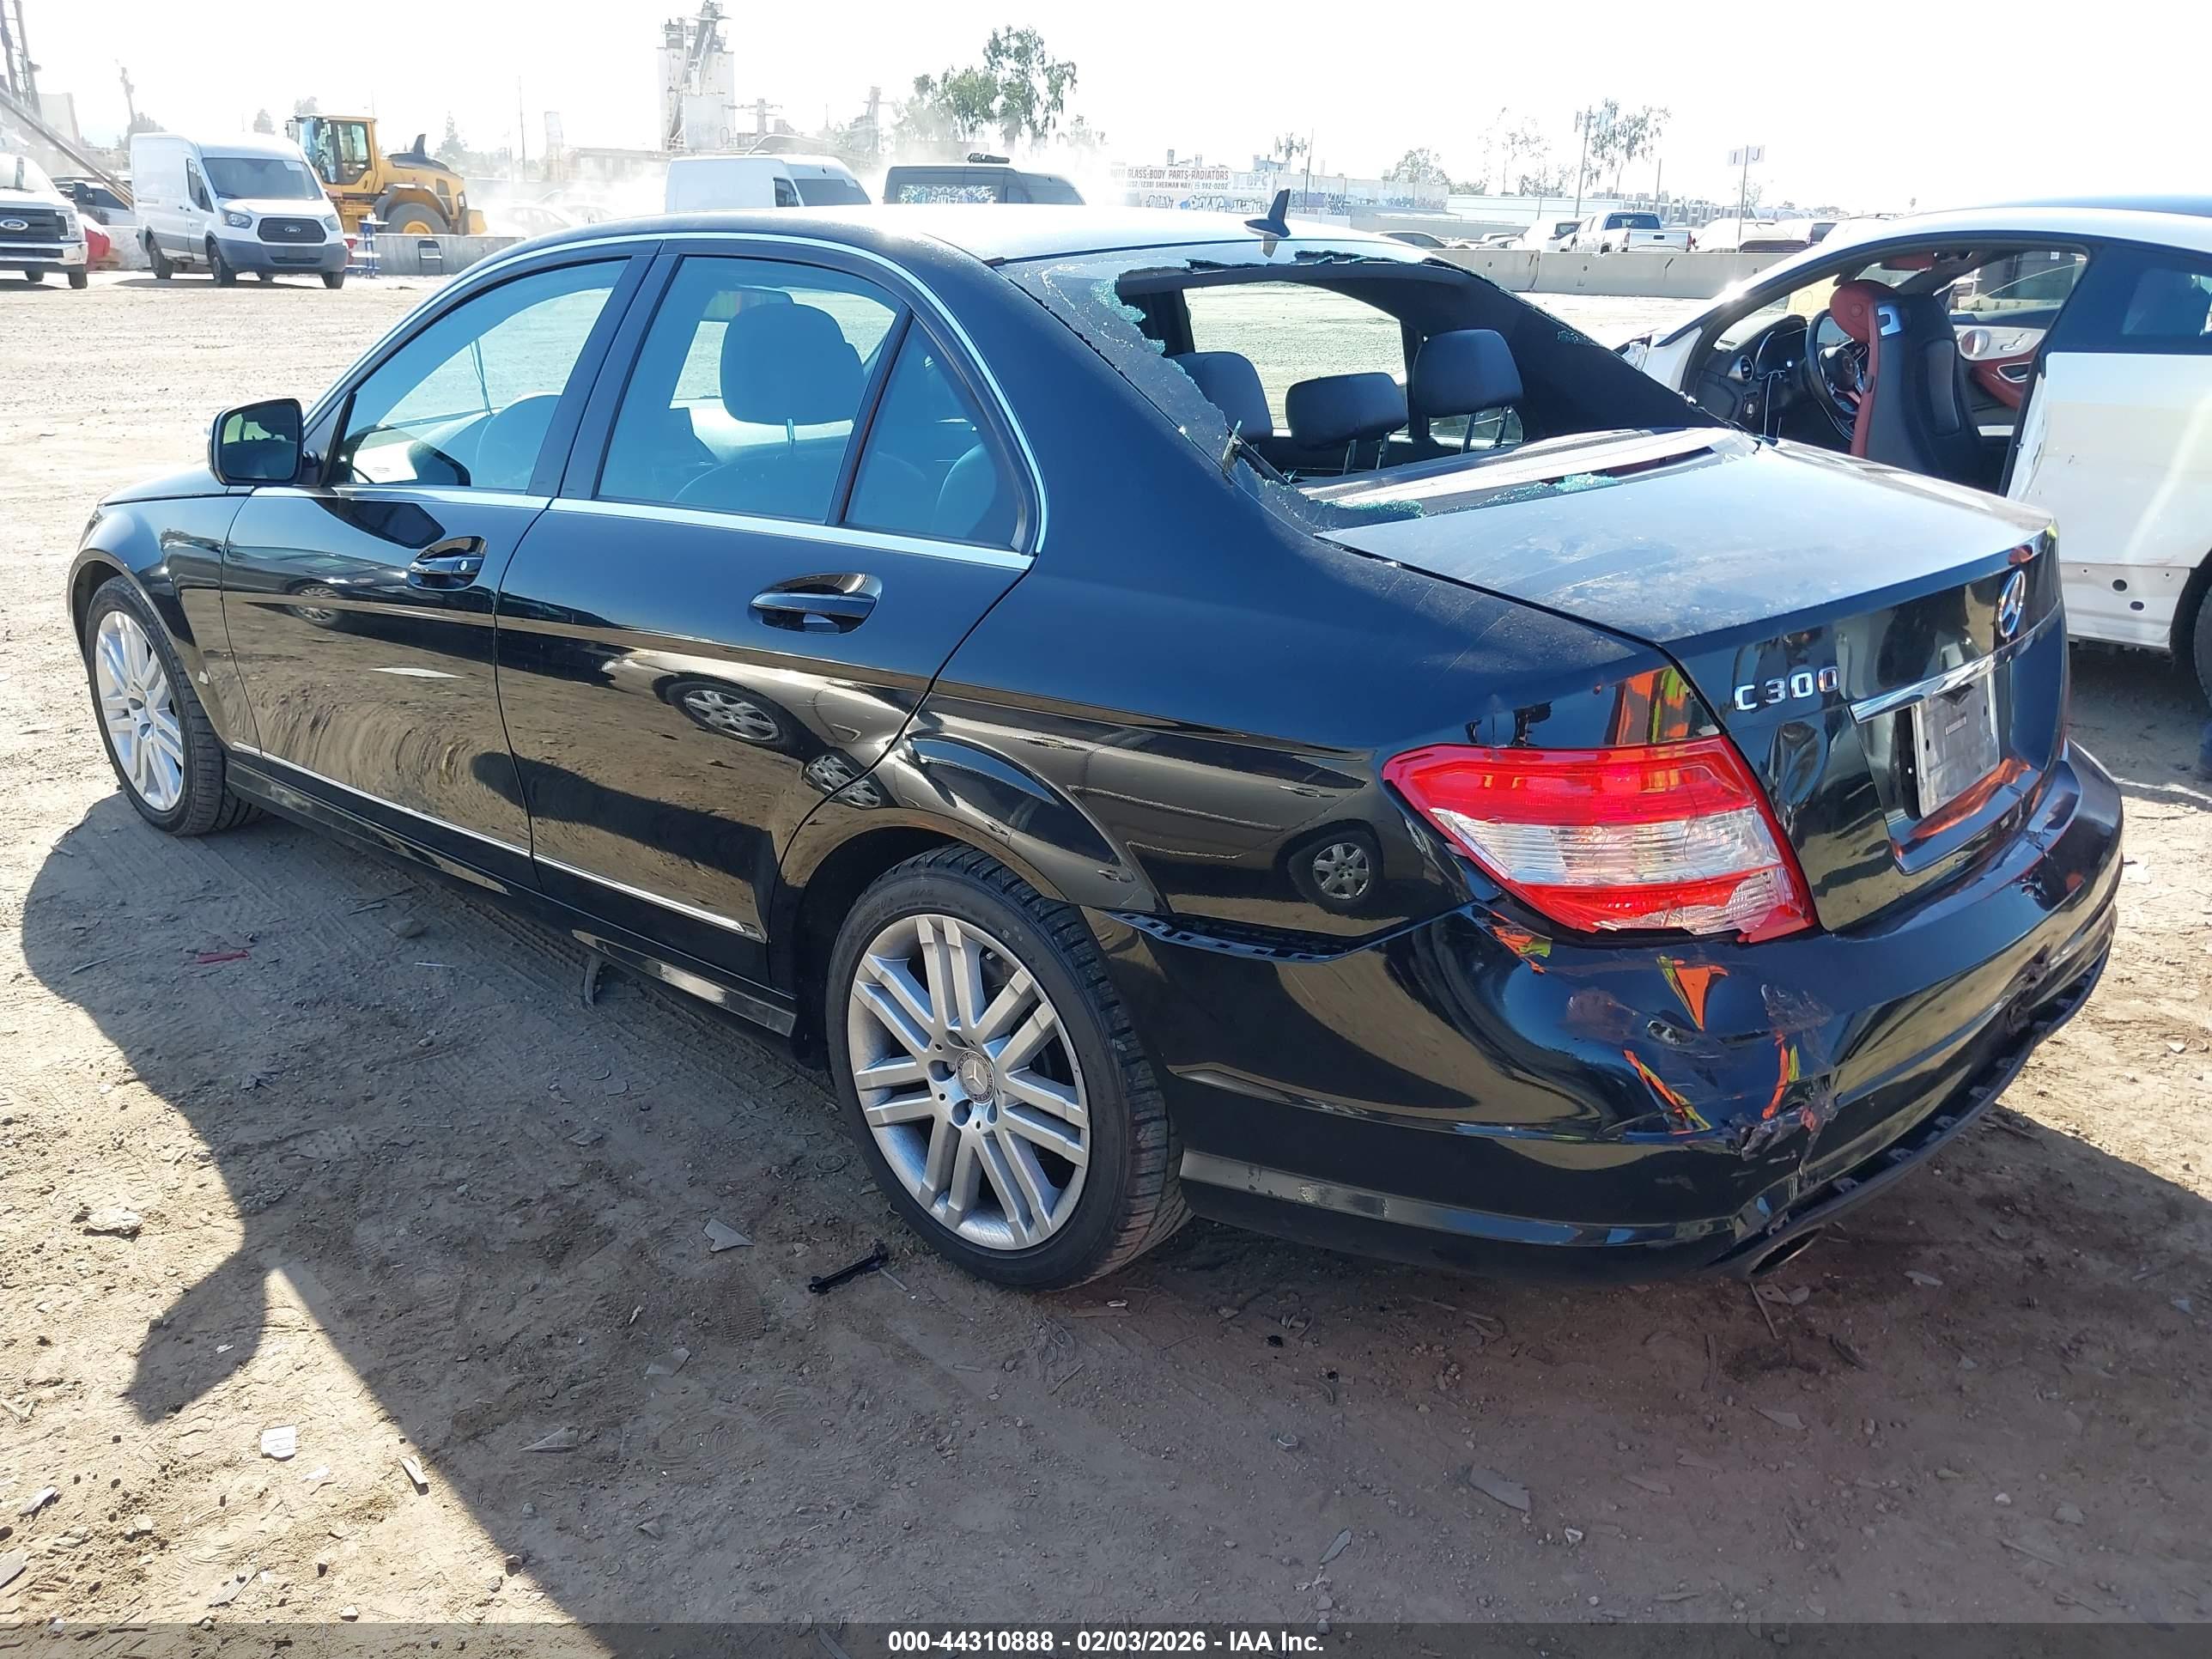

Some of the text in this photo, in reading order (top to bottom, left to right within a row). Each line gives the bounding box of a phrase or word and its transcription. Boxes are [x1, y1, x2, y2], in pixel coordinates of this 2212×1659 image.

[1752, 148, 1760, 161] J
[1169, 169, 1229, 180] PARTS-RADIATORS
[1155, 180, 1179, 189] SHERMAN
